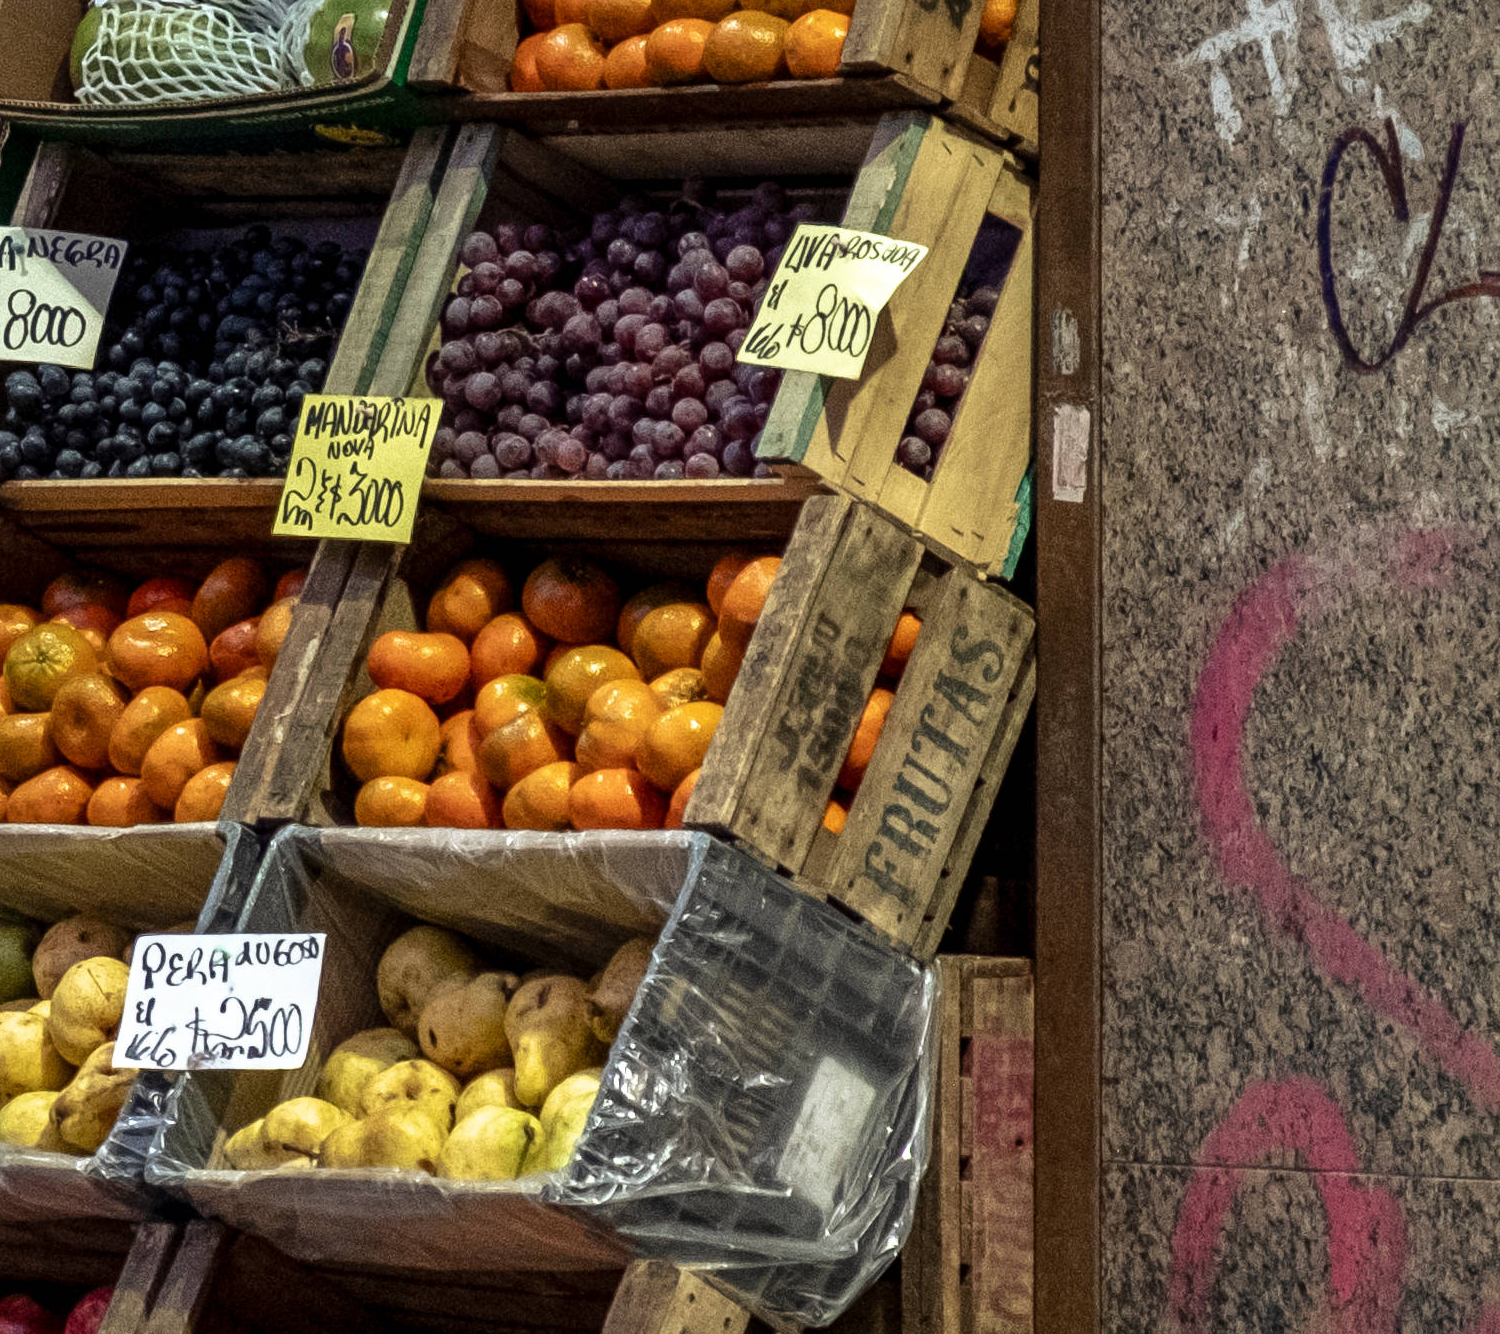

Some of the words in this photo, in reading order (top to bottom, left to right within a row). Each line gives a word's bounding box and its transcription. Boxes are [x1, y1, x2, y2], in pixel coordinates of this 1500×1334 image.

[26, 236, 121, 269] NEGRA
[784, 232, 839, 274] UVA
[304, 398, 432, 449] MANDARINA
[328, 437, 375, 460] NOVA
[862, 625, 1006, 909] FRUTAS
[142, 942, 230, 989] PERA
